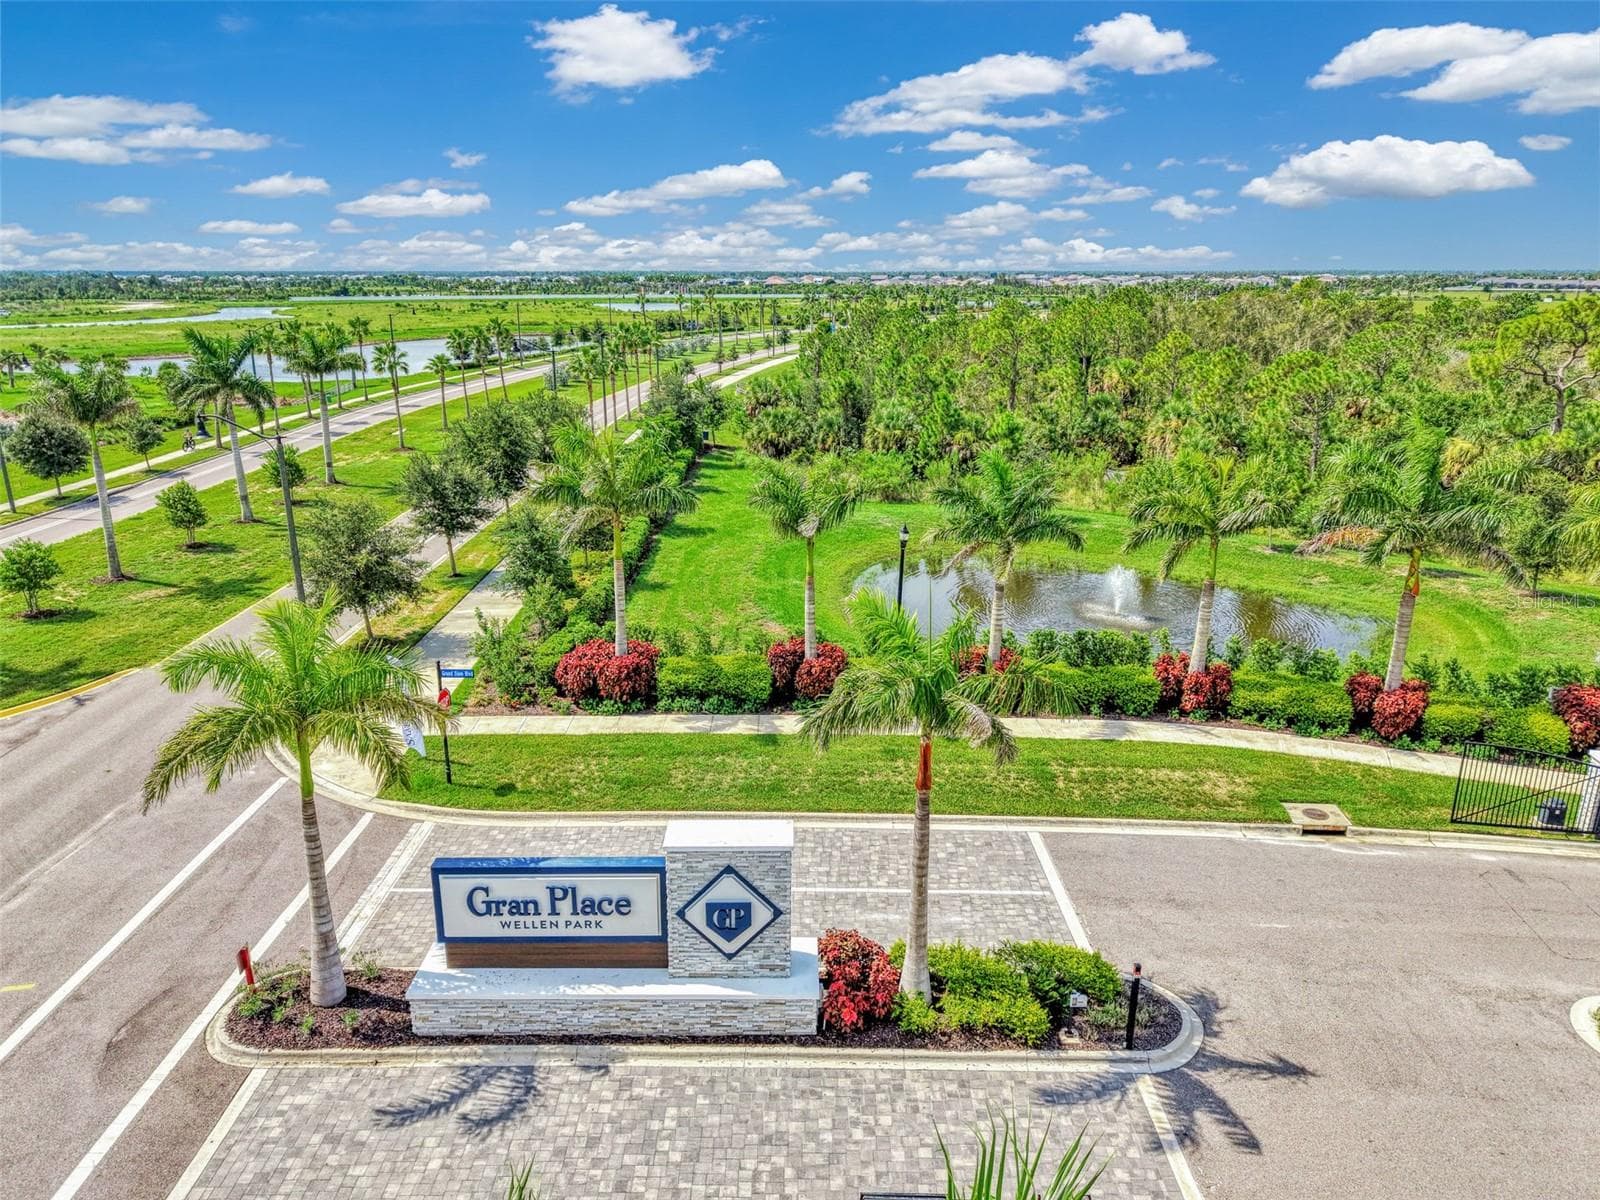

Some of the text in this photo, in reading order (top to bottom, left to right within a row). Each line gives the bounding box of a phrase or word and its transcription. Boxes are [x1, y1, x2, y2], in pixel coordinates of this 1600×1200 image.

[466, 885, 632, 917] Gran Place
[500, 919, 604, 930] WELLEN PARK
[713, 908, 745, 929] GP
